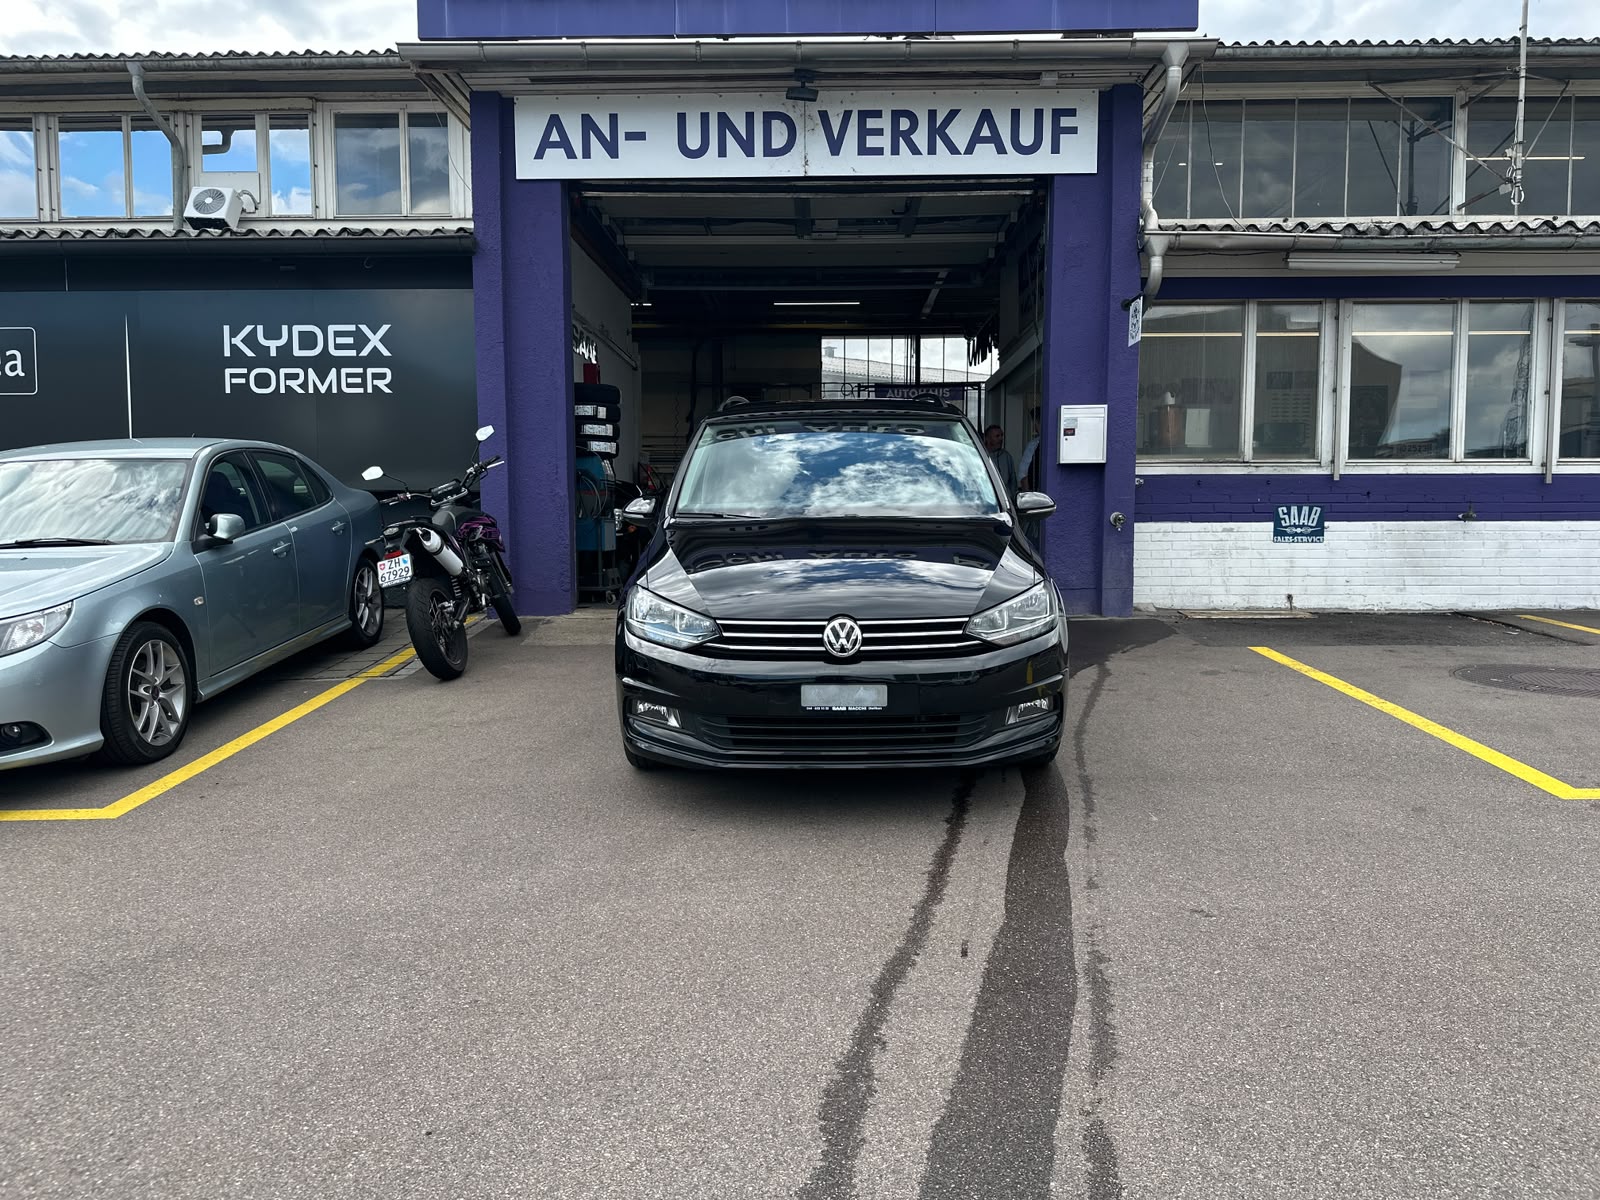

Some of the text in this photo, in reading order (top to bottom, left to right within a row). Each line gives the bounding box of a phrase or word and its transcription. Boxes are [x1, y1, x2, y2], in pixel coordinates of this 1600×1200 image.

[534, 106, 1079, 160] AN- UND VERKAUF
[222, 323, 393, 357] KYDEX
[224, 366, 393, 394] FORMER
[1278, 506, 1321, 526] SAAB
[380, 566, 410, 582] 67929
[387, 557, 401, 570] ZH
